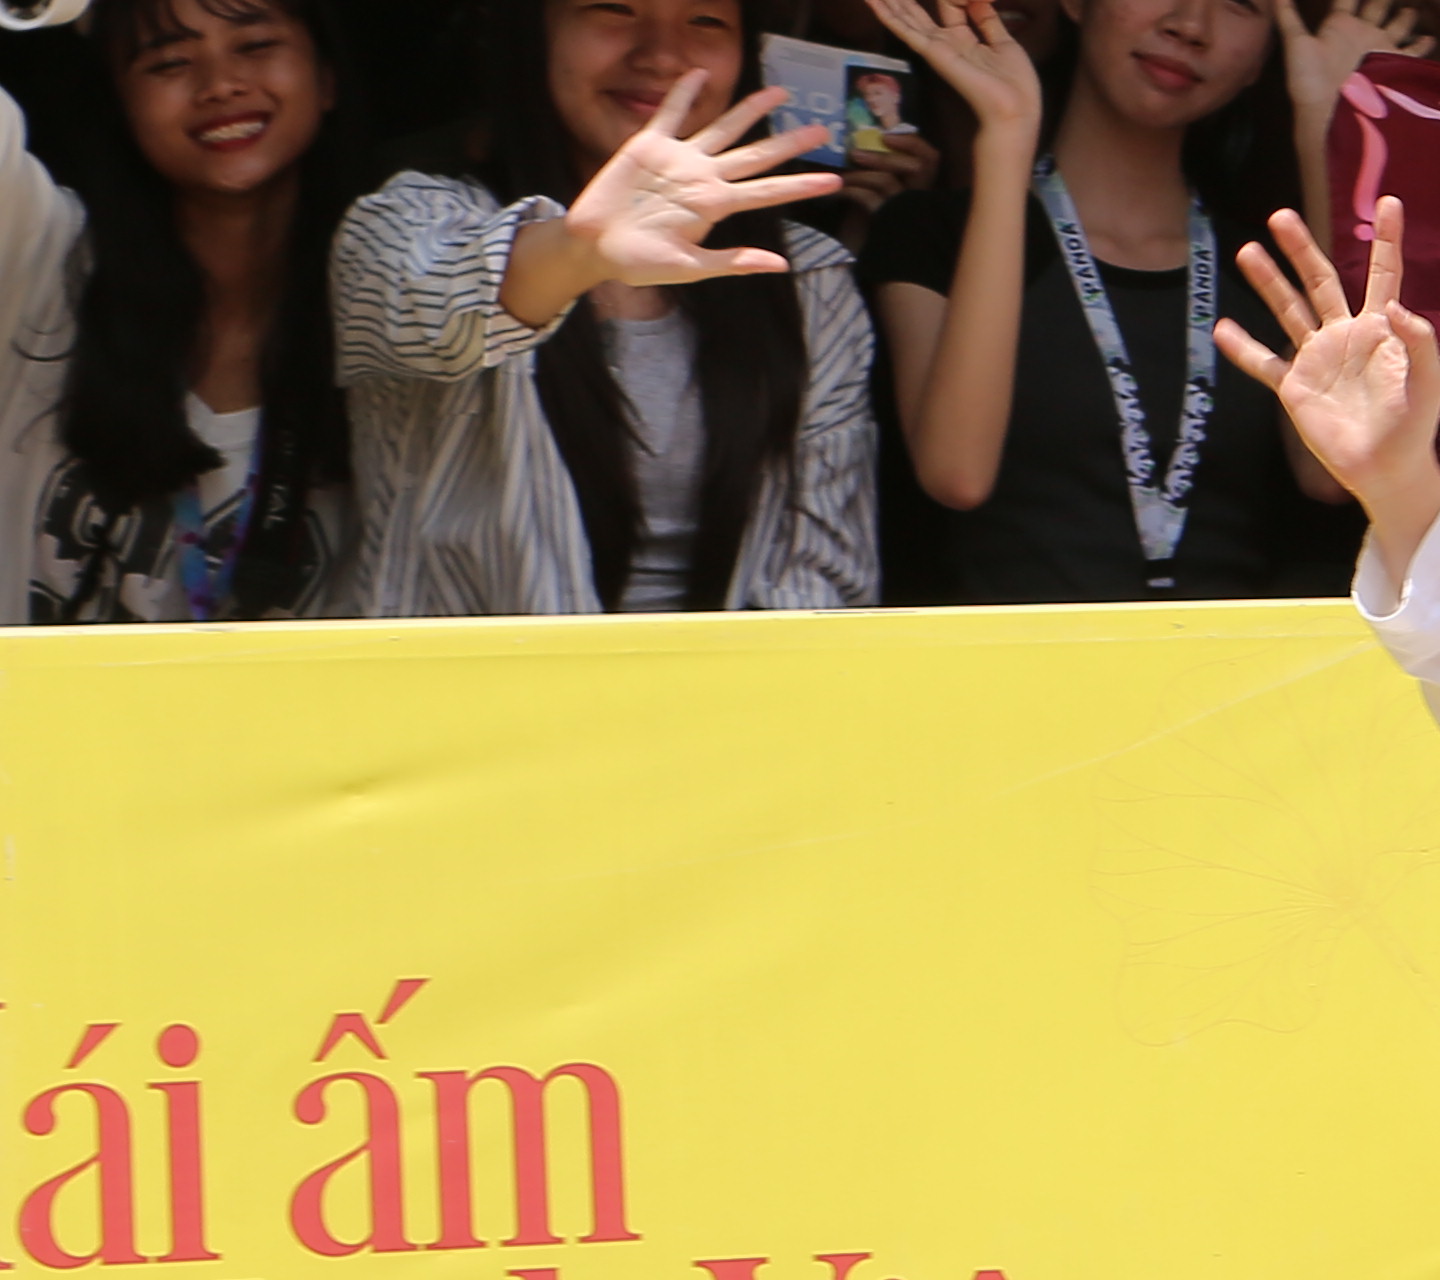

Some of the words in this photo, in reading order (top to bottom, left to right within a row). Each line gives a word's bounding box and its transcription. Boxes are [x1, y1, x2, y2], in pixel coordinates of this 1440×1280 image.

[1056, 220, 1105, 303] PANDA
[1190, 245, 1217, 325] PANDA
[0, 1020, 221, 1270] ái
[287, 976, 644, 1258] ấm
